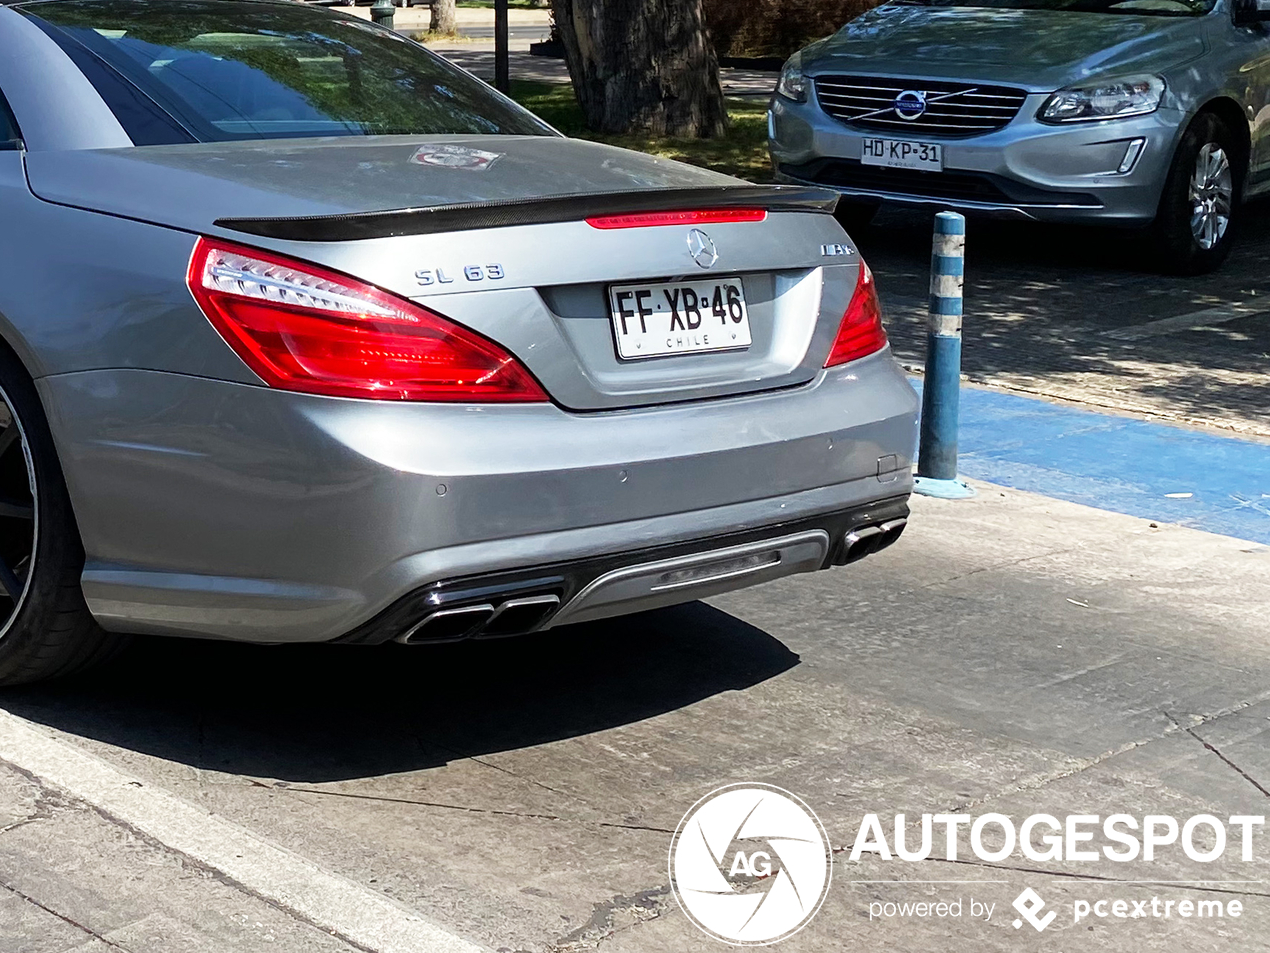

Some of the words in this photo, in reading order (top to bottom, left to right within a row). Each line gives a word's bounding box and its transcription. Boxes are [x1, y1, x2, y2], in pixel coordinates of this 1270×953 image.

[415, 267, 454, 286] SL
[463, 263, 505, 282] 63
[666, 334, 709, 348] CHILE
